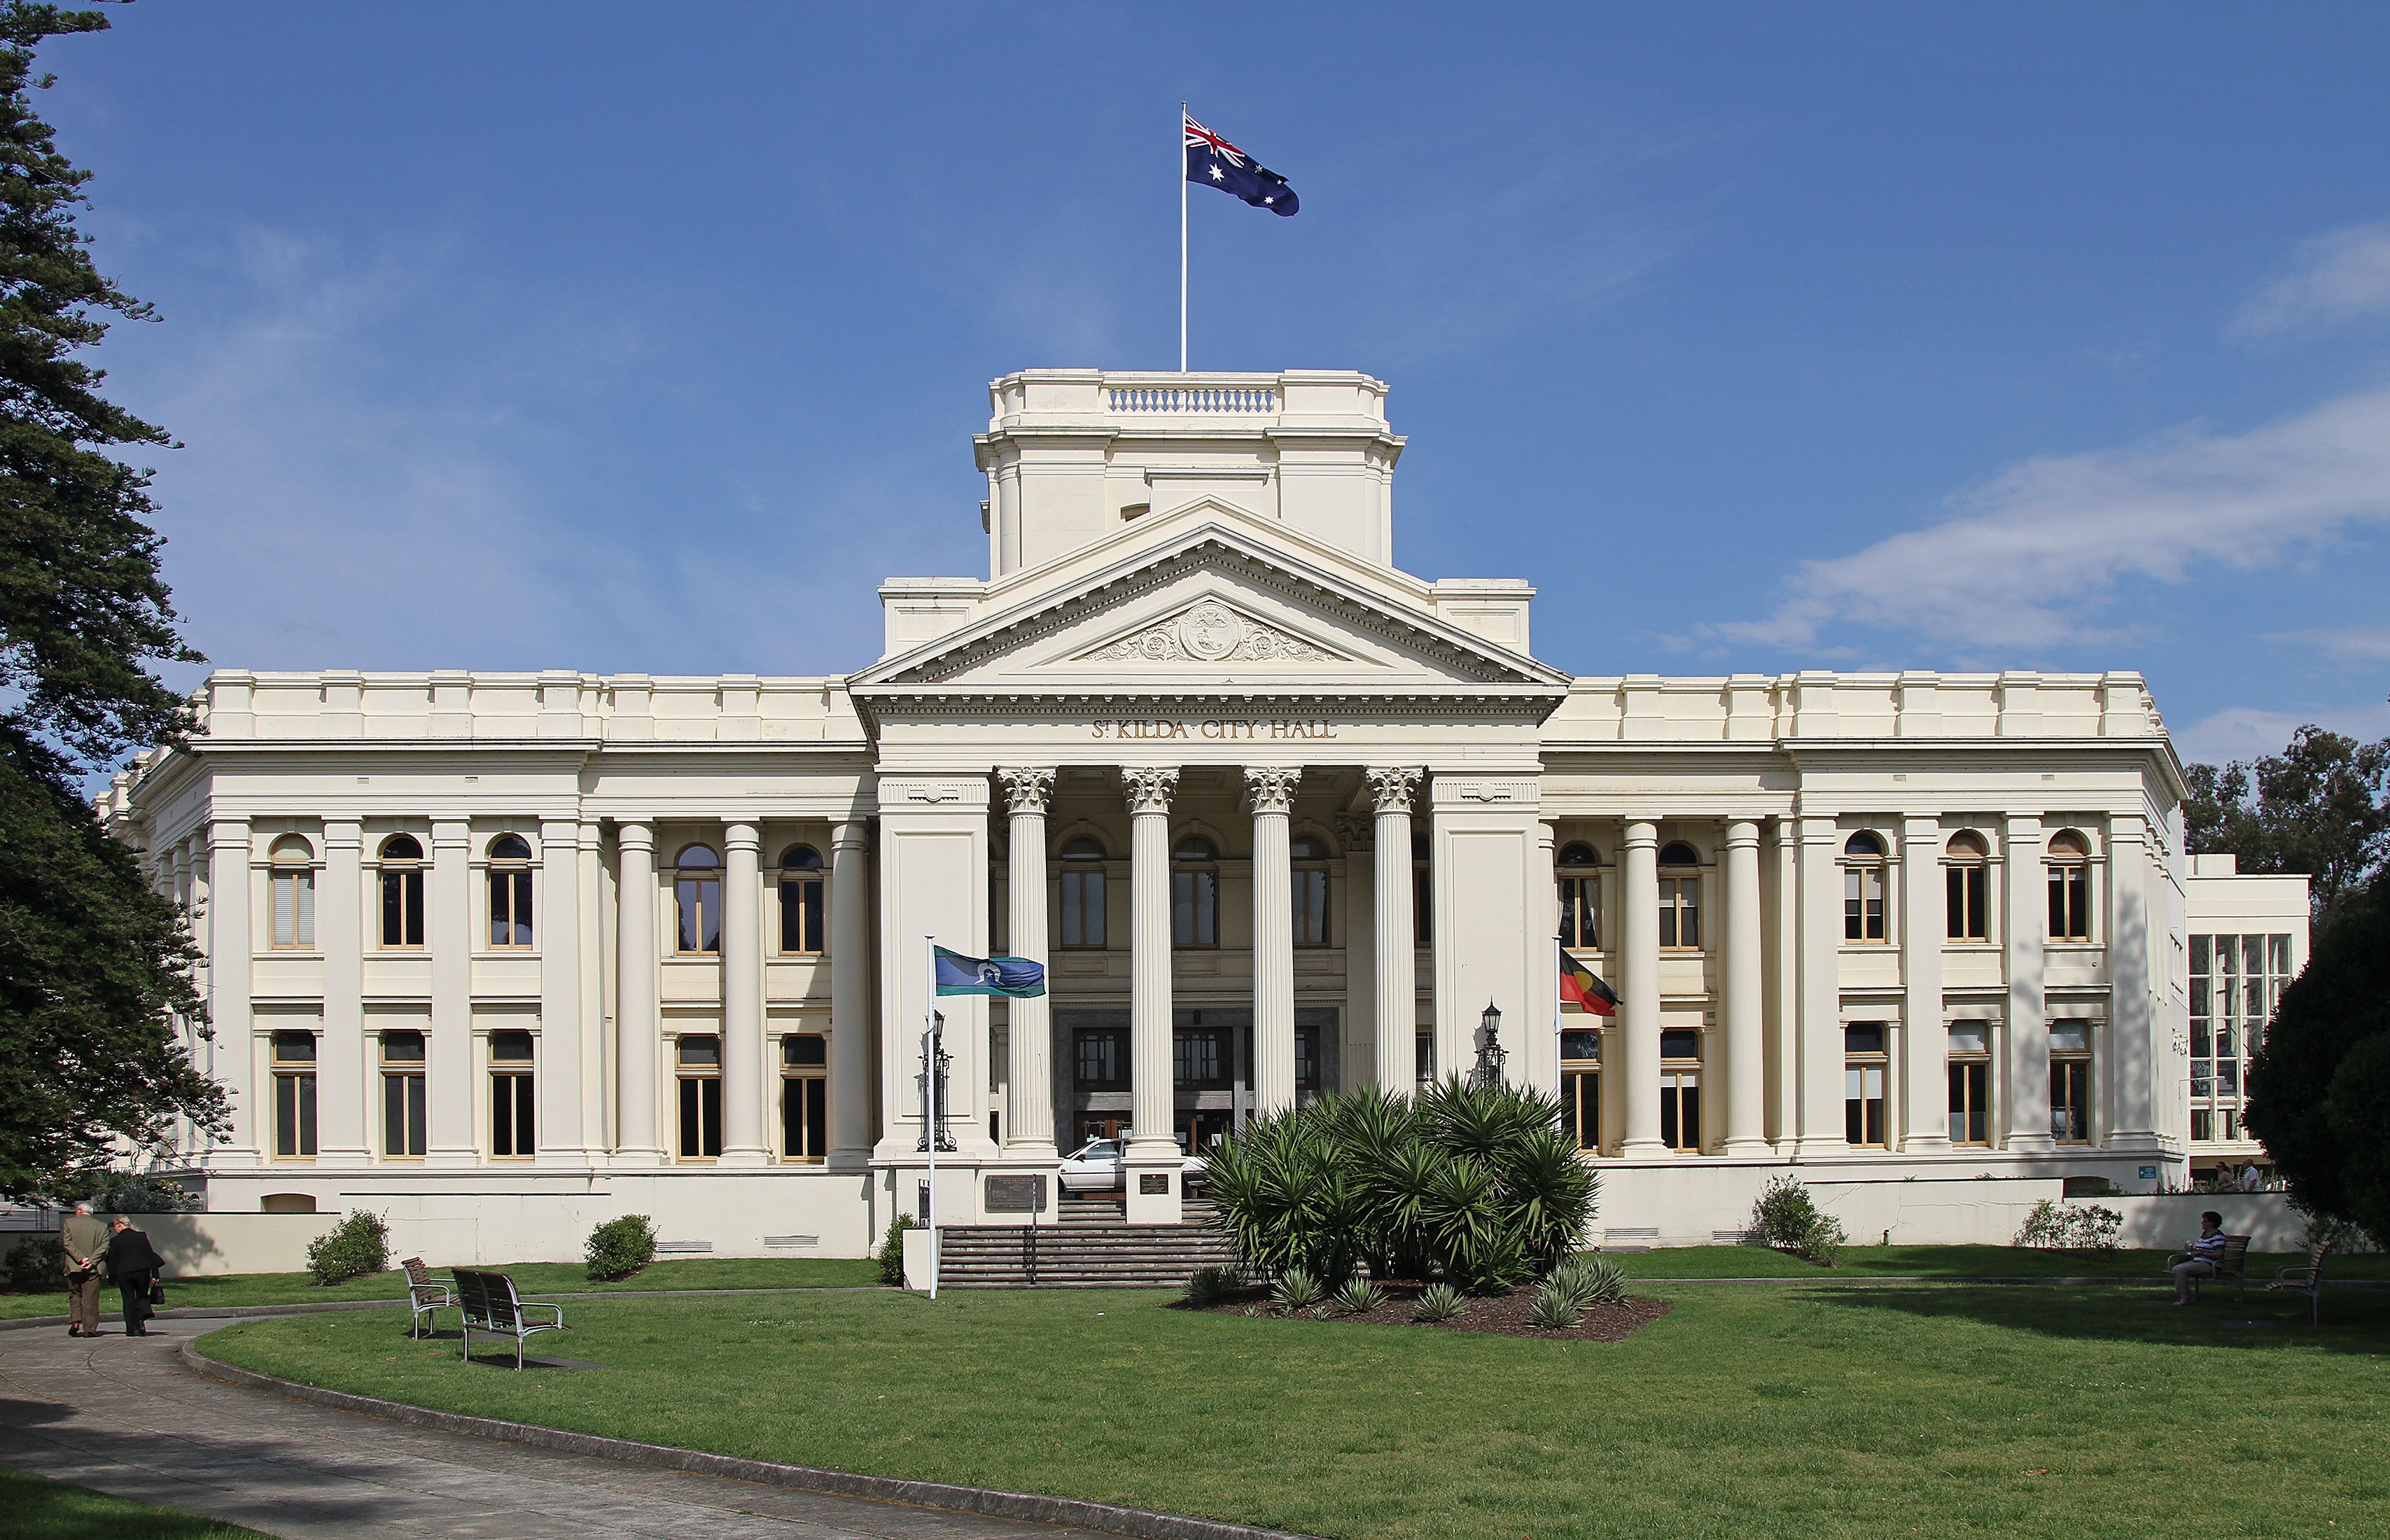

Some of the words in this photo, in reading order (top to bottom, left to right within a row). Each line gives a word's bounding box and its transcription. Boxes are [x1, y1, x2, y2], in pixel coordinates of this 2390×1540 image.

[1116, 720, 1189, 738] KILDA
[1201, 720, 1259, 738] CITY
[1269, 720, 1337, 738] HALL
